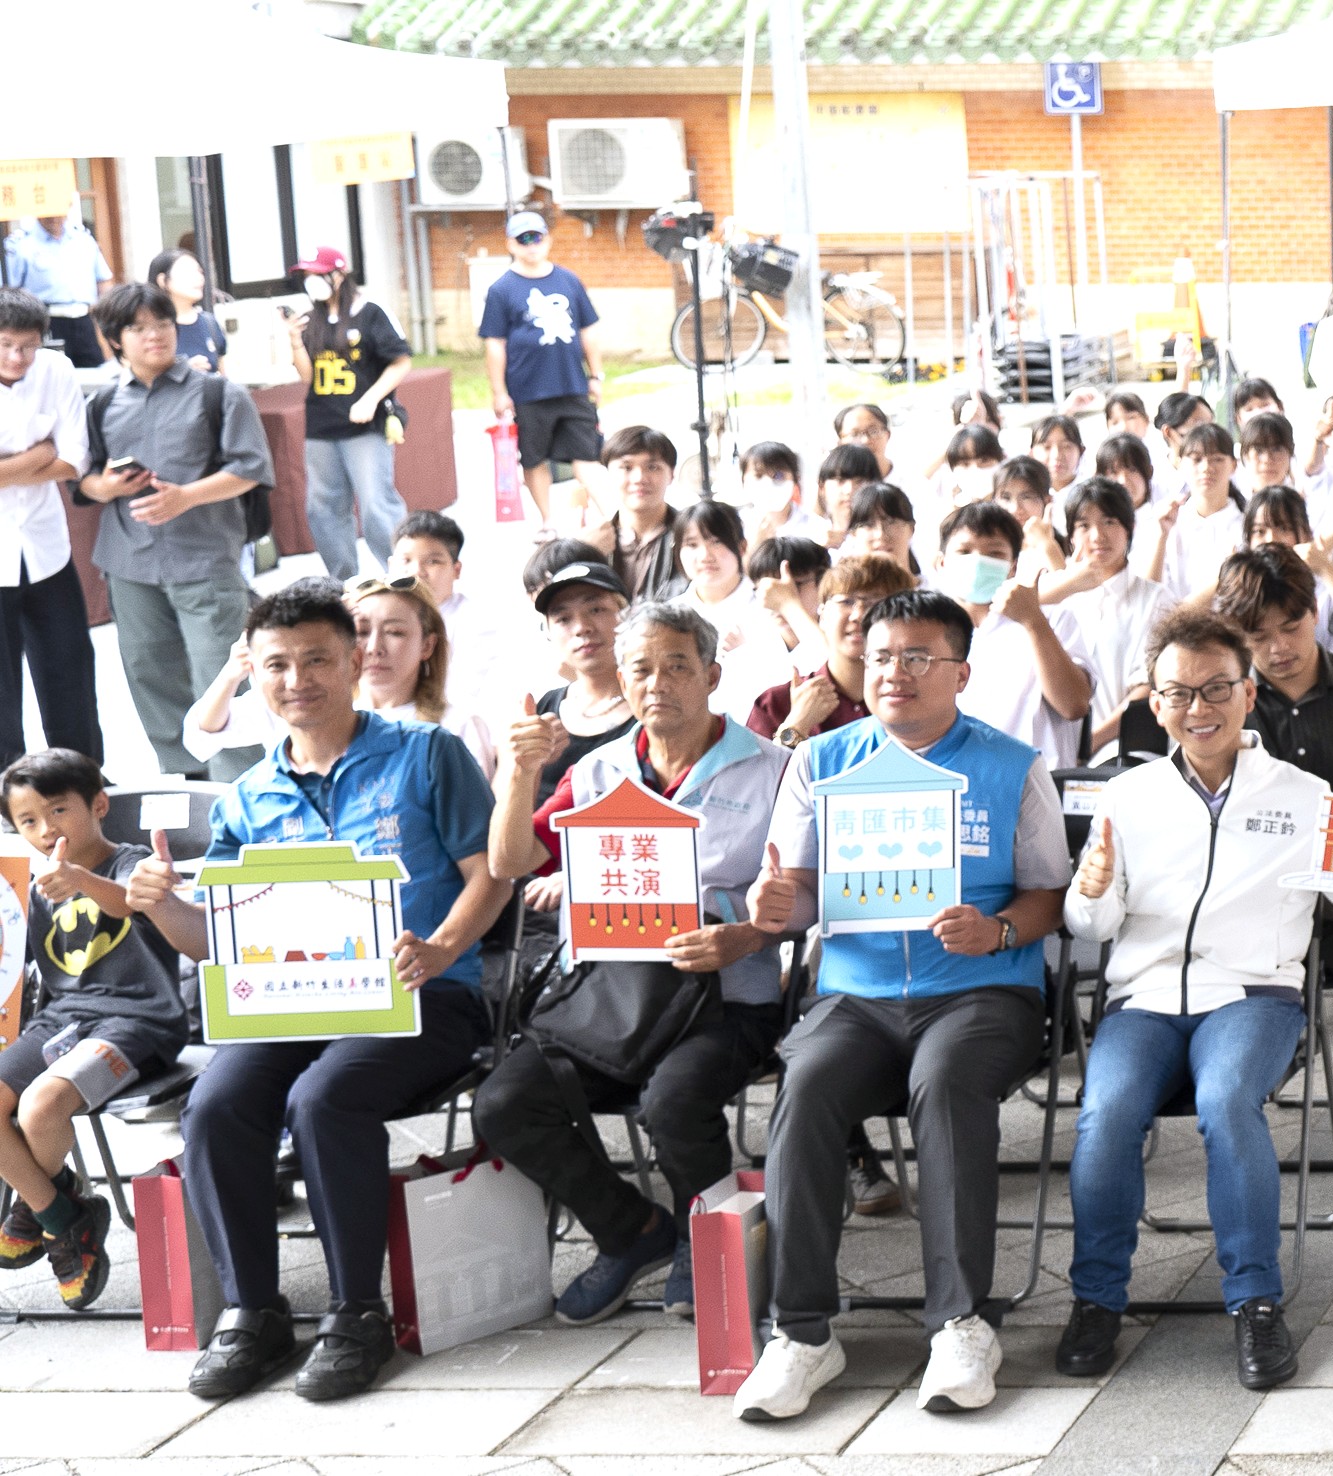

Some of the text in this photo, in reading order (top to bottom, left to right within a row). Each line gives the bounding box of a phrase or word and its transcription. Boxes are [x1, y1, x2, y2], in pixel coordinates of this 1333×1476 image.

[314, 358, 356, 395] 05
[833, 806, 947, 836] 青匯市集
[599, 834, 659, 862] 專業
[600, 868, 661, 896] 共演
